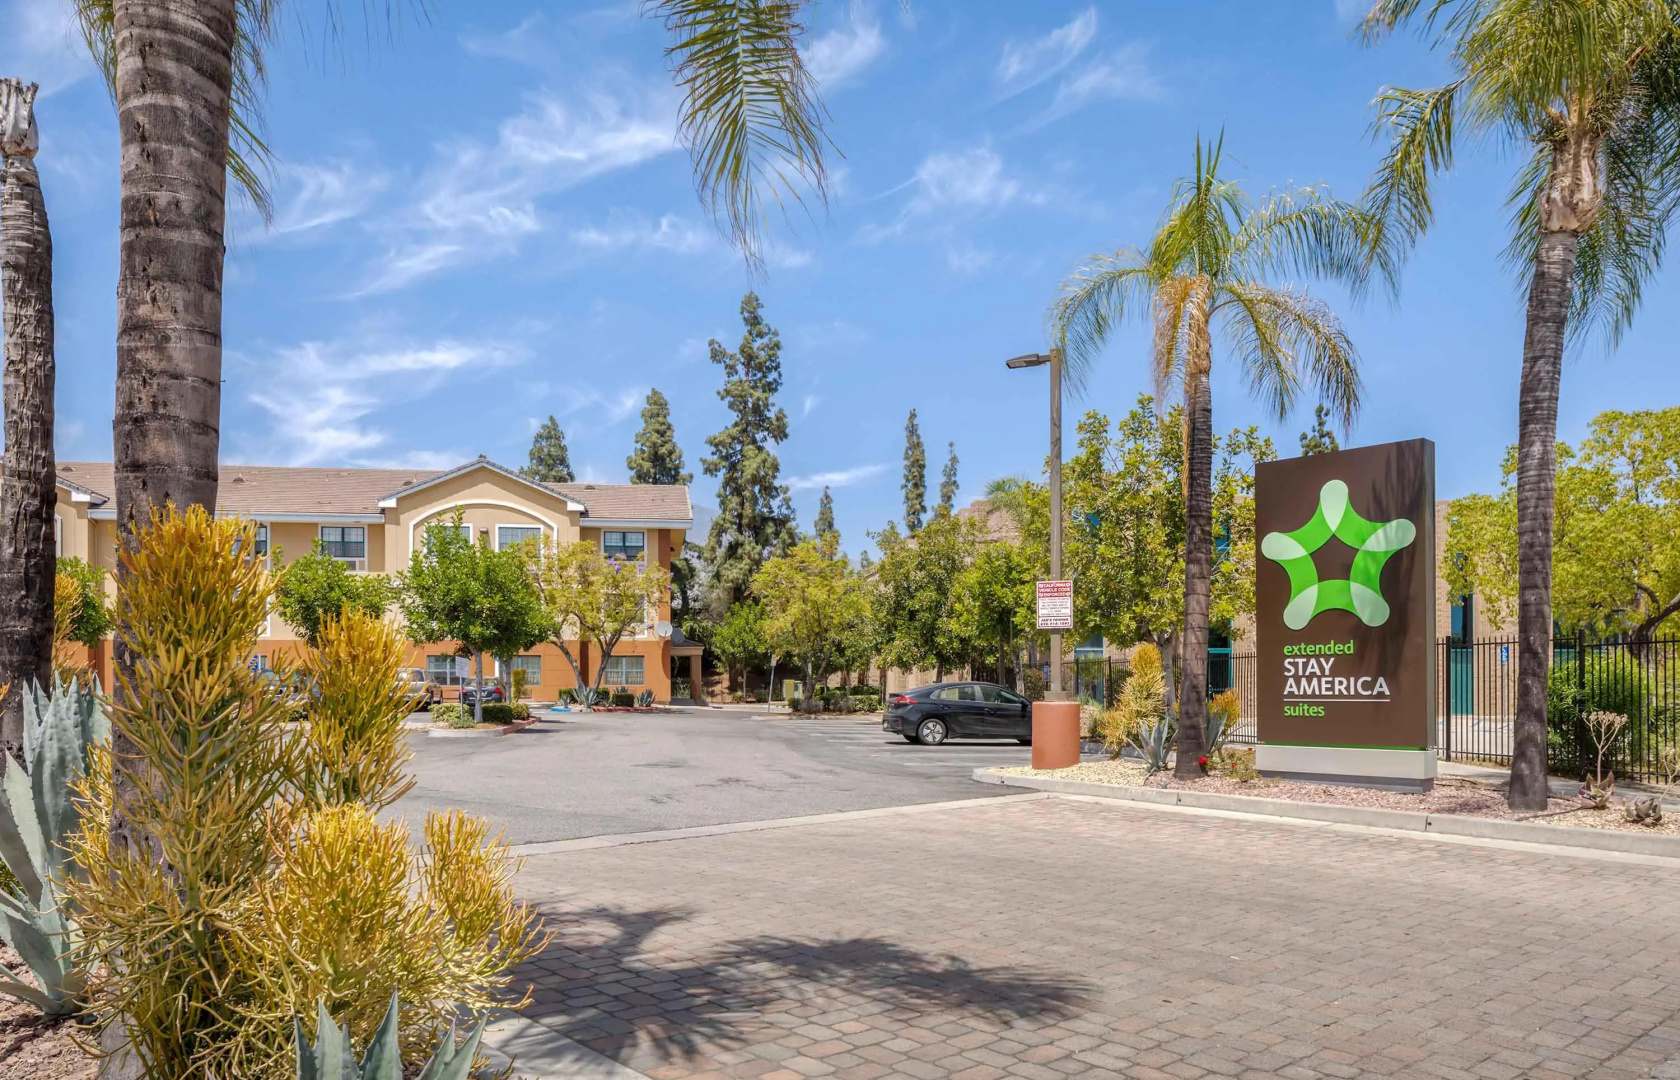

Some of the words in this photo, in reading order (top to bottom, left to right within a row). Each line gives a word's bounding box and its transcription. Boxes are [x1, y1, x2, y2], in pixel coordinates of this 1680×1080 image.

[1284, 639, 1354, 656] extended
[1284, 657, 1335, 676] STAY
[1283, 676, 1391, 695] AMERICA
[1284, 703, 1325, 717] suites
